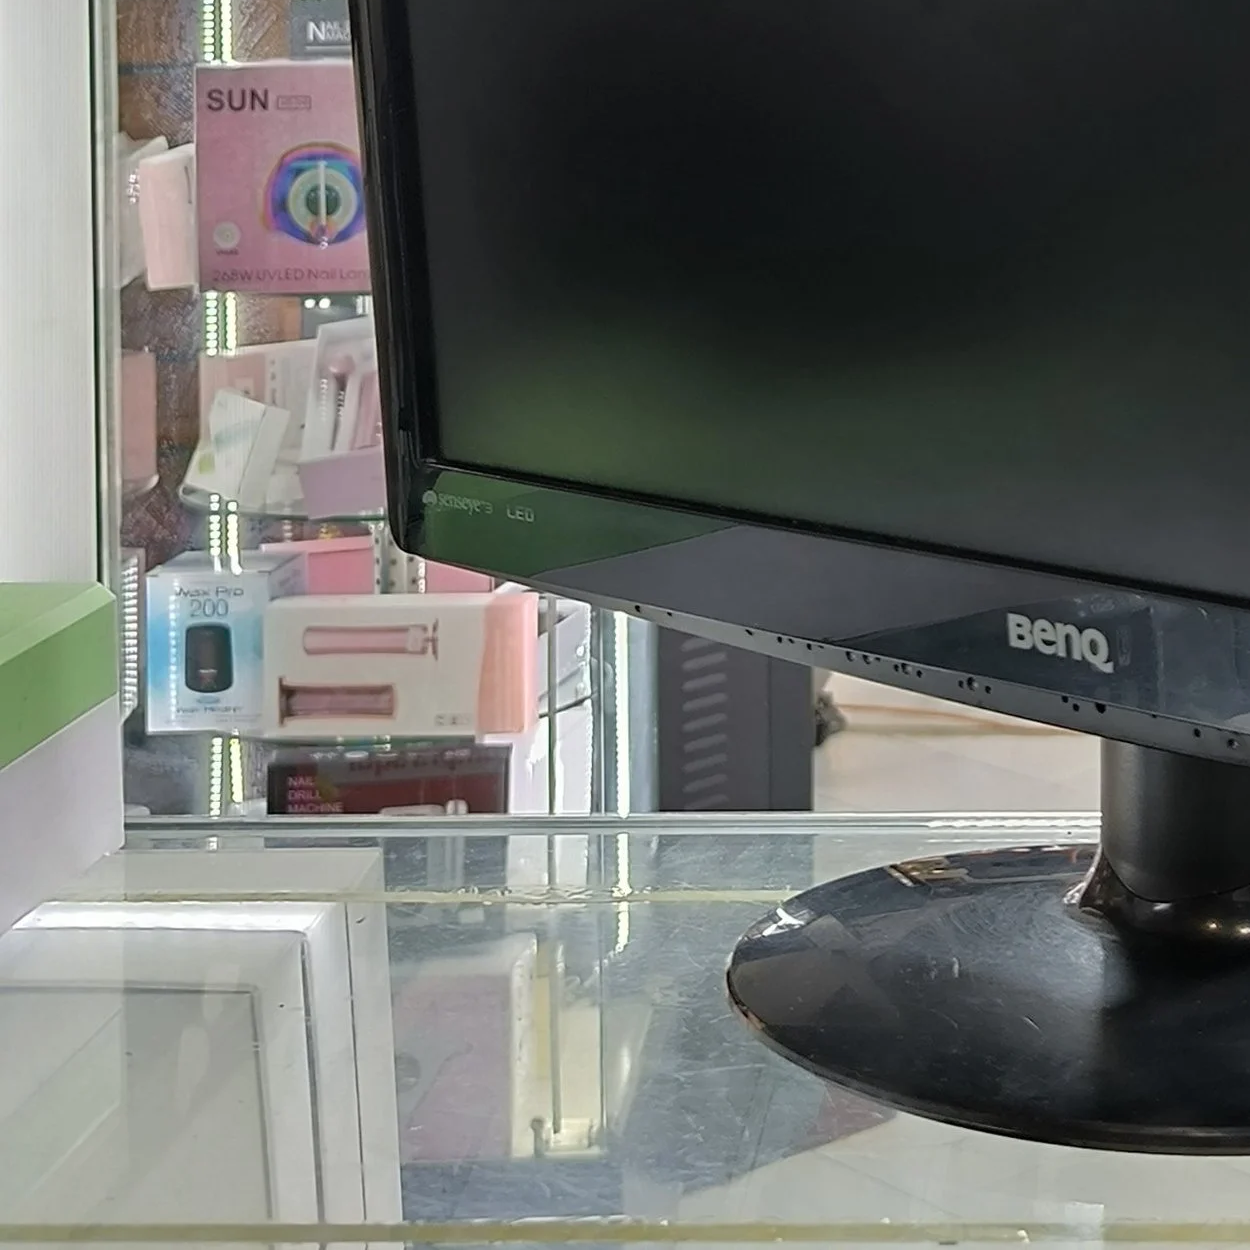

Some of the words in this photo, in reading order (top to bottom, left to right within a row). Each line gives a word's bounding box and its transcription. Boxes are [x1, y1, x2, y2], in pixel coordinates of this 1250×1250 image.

[207, 88, 269, 111] SUN
[308, 267, 338, 281] Nail
[506, 504, 535, 522] LED
[190, 599, 229, 618] 200
[1007, 612, 1114, 674] BenQ
[287, 789, 322, 800] DRILL
[287, 802, 344, 813] MACHINE
